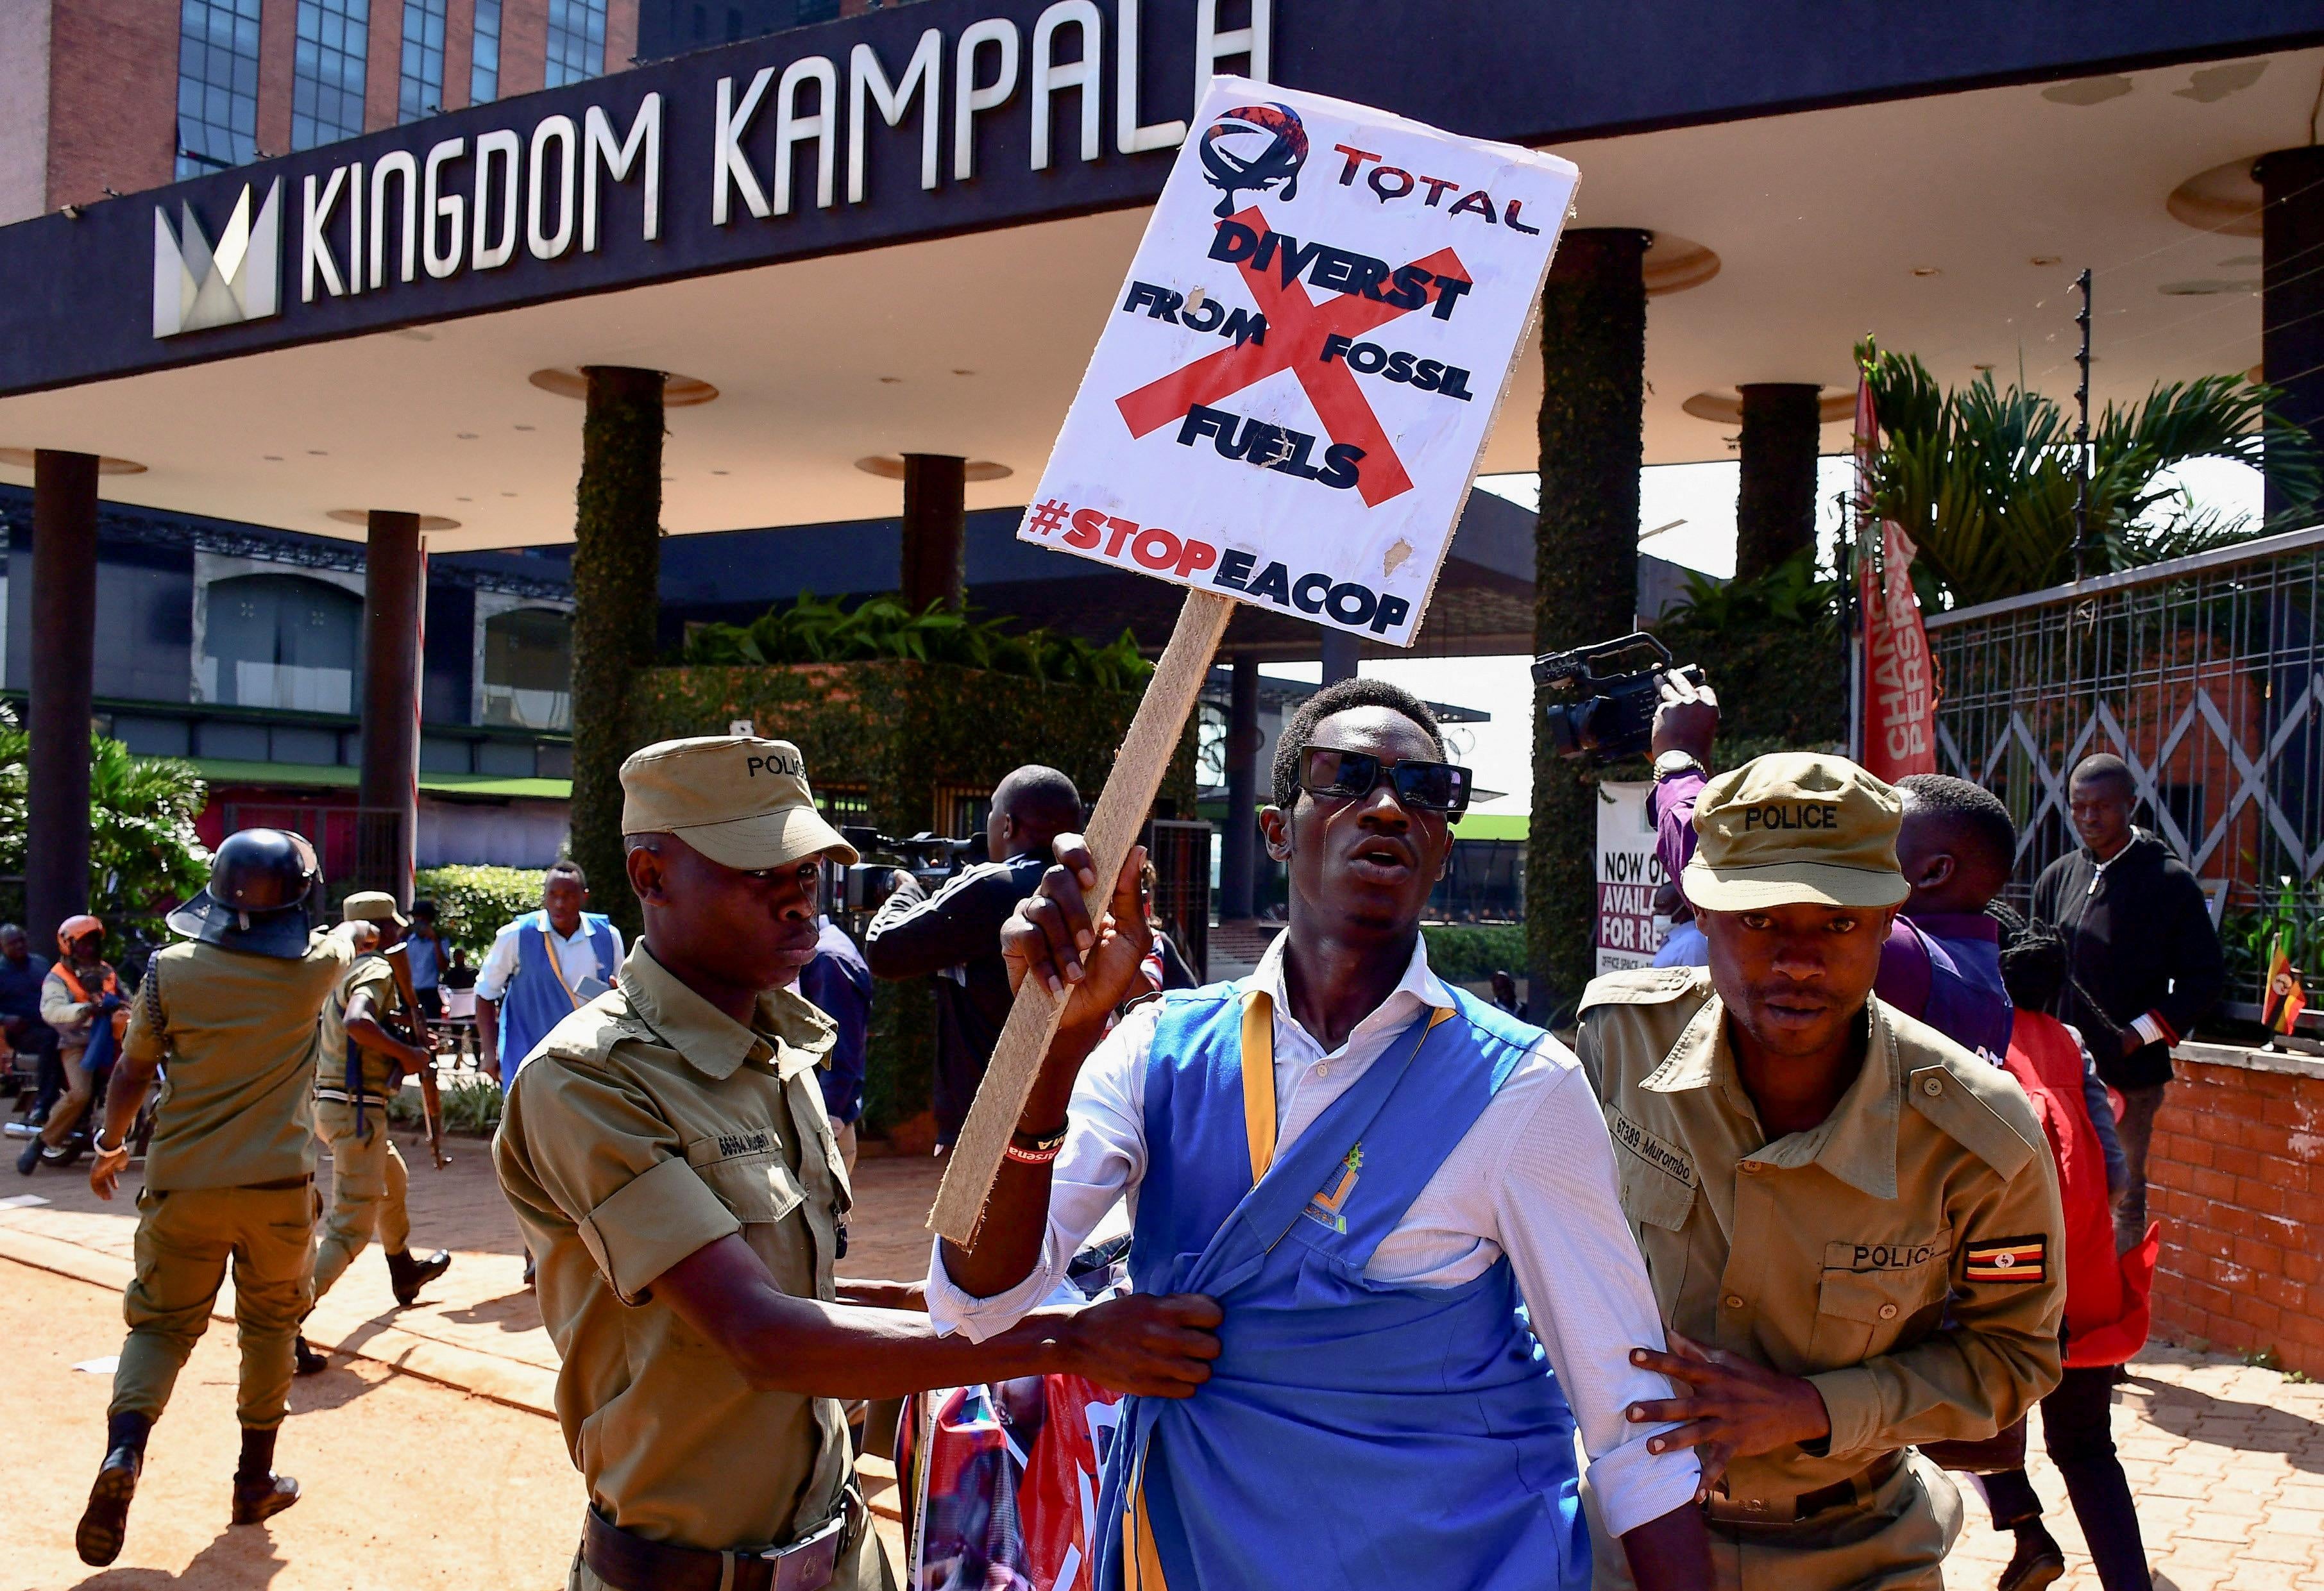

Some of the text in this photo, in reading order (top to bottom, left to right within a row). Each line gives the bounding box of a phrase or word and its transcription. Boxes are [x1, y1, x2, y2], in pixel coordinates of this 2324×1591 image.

[301, 92, 661, 304] KINGDOM
[1334, 144, 1540, 236] TOTAL
[1207, 219, 1473, 322] DIVERST
[1123, 280, 1473, 402] FROM FOSSIL
[1176, 403, 1368, 490] FUELS
[747, 755, 806, 780] POLIC
[1745, 804, 1838, 831] POLICE
[1605, 852, 1643, 882] NOW
[1601, 915, 1635, 949] FOR
[1616, 1116, 1690, 1181] 67389 Murombo
[1853, 1245, 1933, 1268] POLIC
